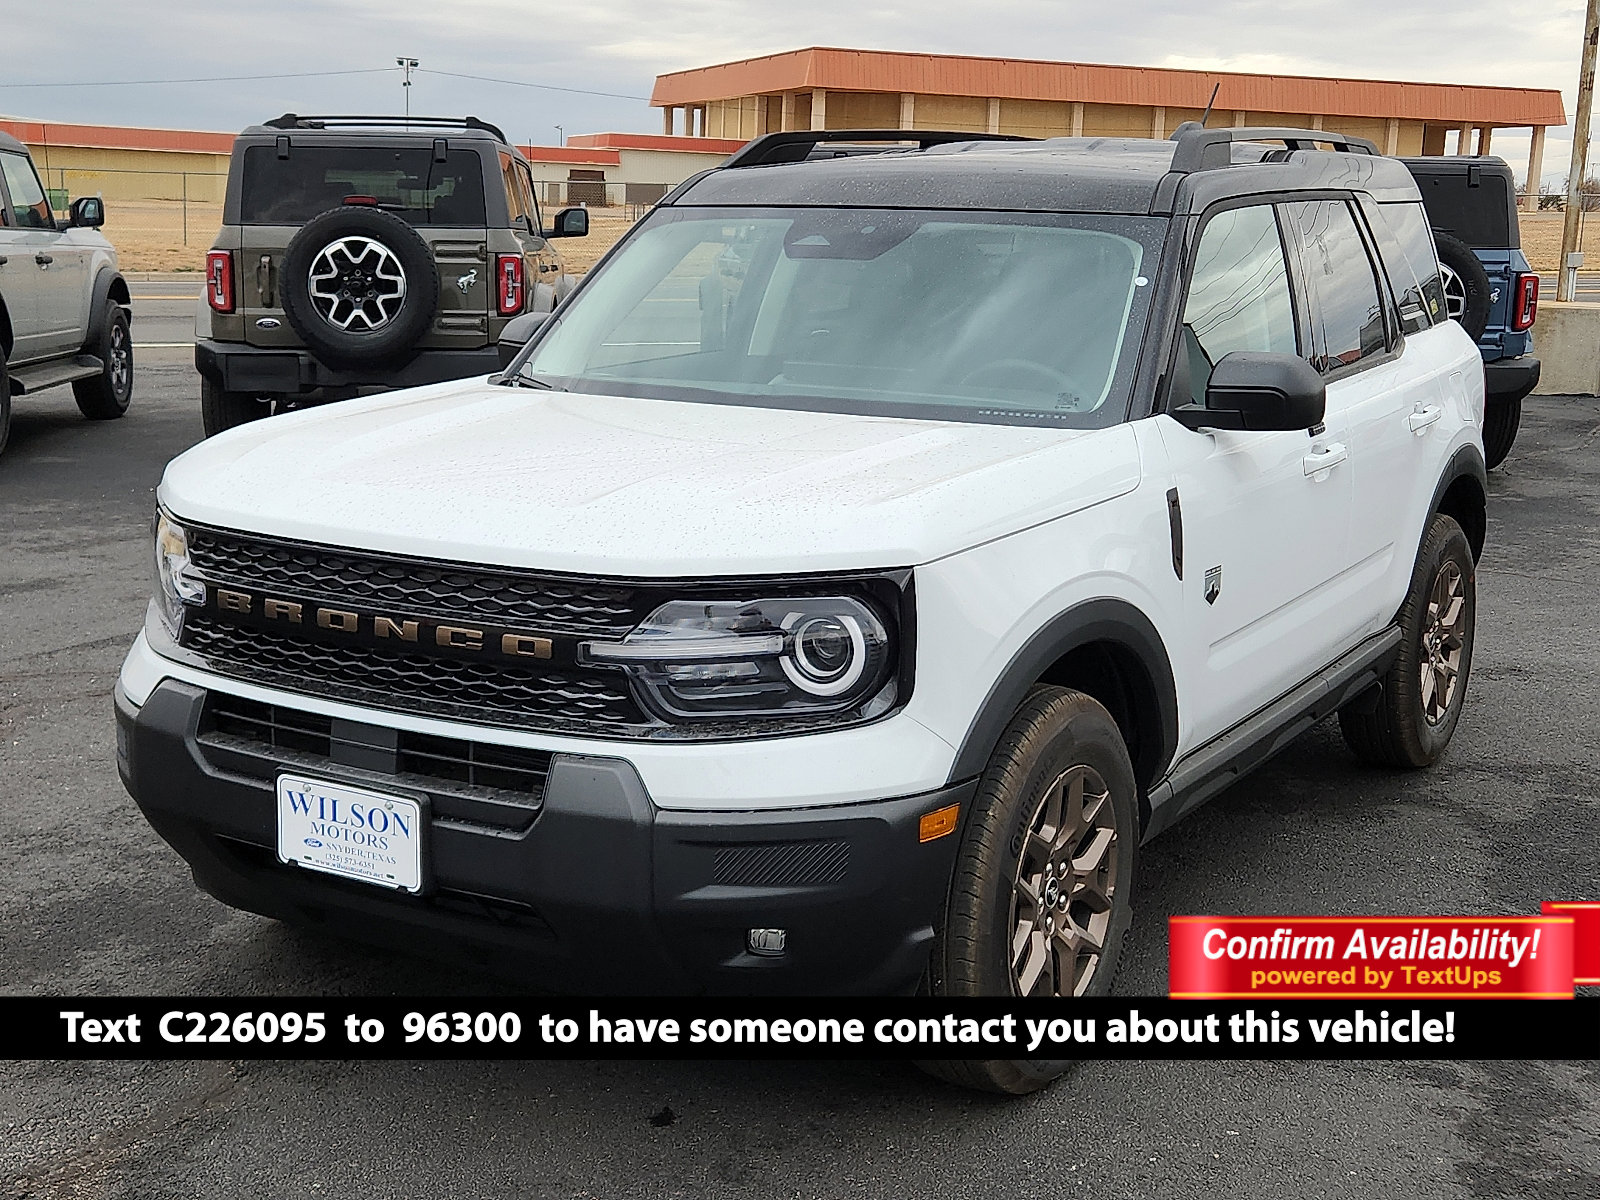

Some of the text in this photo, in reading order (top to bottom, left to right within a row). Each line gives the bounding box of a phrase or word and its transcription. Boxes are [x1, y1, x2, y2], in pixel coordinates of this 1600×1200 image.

[217, 588, 553, 660] BRONCO
[286, 789, 412, 840] WILSON
[310, 821, 389, 851] MOTORS
[325, 853, 343, 863] (325)
